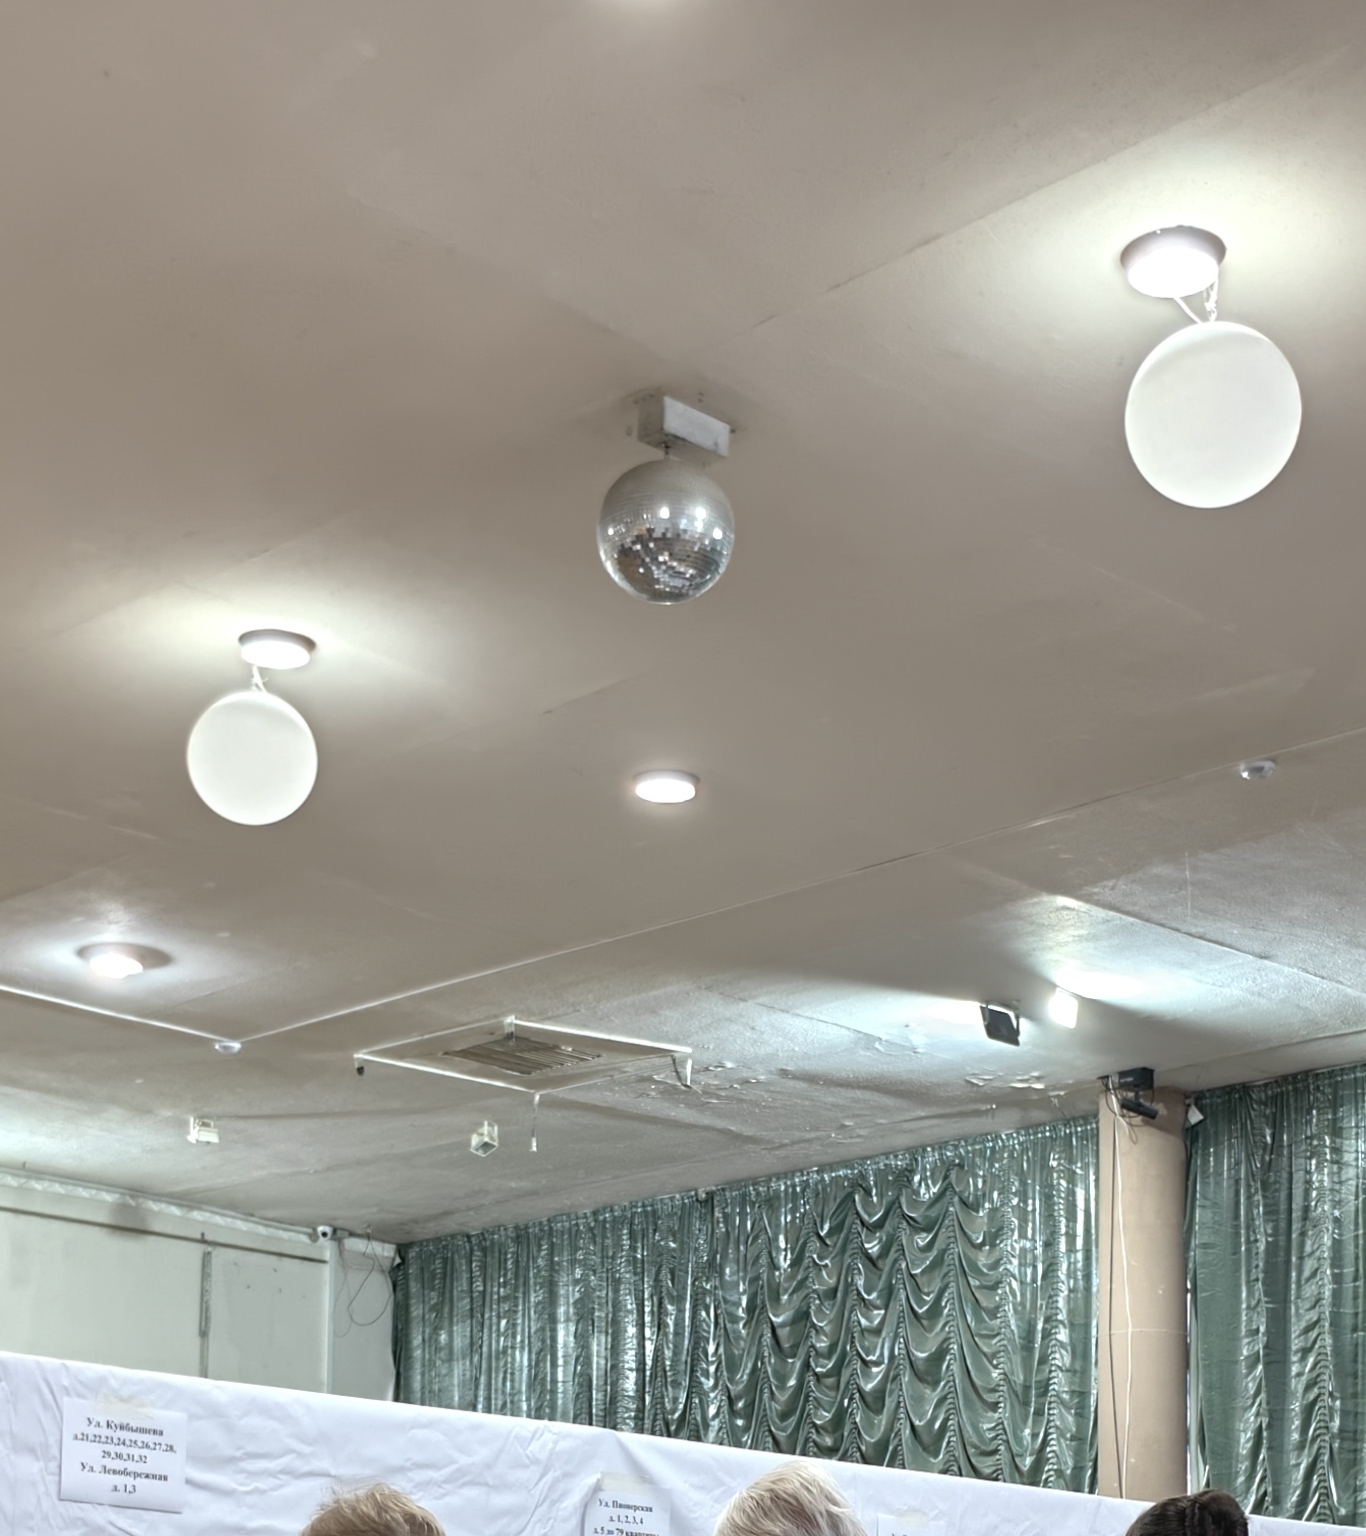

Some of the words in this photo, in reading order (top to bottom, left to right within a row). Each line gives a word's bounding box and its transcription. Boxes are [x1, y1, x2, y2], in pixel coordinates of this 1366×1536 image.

[86, 1416, 103, 1429] Ул.
[106, 1420, 164, 1437] Куйбышева
[80, 1461, 96, 1473] Ул.
[99, 1465, 169, 1482] Левобережная
